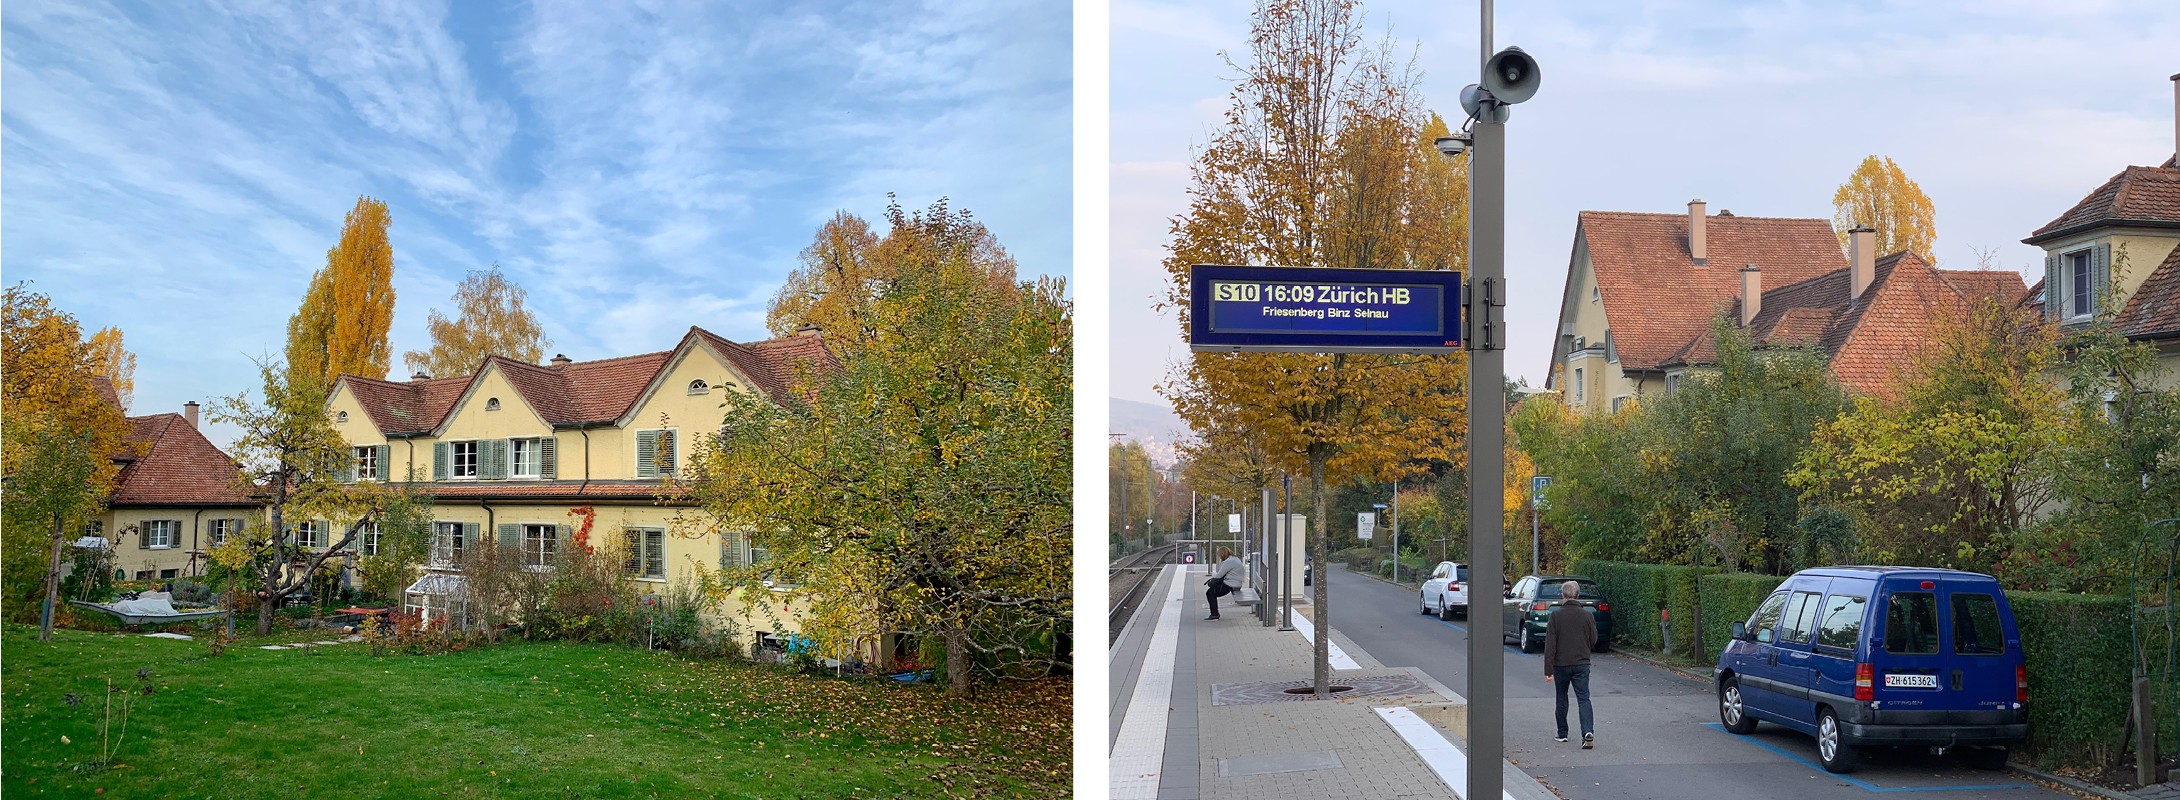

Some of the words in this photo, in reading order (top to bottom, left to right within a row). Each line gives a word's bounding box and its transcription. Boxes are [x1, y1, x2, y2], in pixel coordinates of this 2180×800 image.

[1219, 284, 1256, 300] S10
[1264, 285, 1314, 303] 16:09
[1317, 286, 1378, 304] Zürich
[1382, 288, 1411, 305] HB
[1263, 307, 1324, 319] Friesenberg
[1328, 308, 1351, 318] Binz
